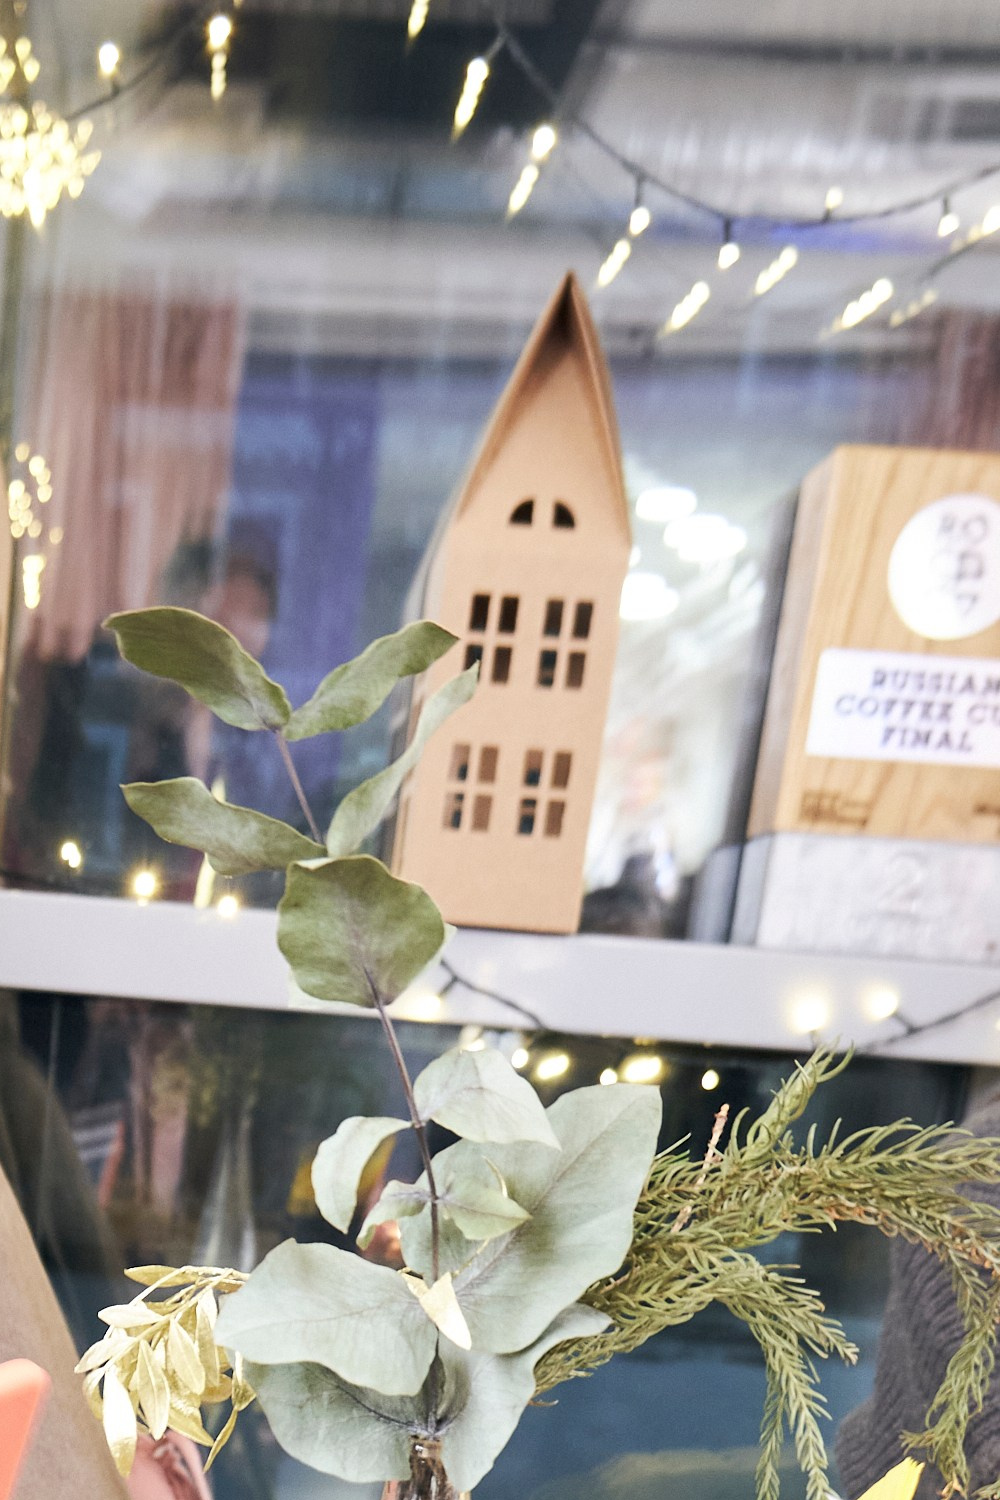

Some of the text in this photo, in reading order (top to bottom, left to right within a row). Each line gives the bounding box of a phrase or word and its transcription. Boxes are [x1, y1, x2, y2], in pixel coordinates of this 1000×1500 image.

[871, 668, 1000, 696] RUSSIAN
[835, 693, 953, 721] COFFEE
[882, 726, 973, 752] FINAL
